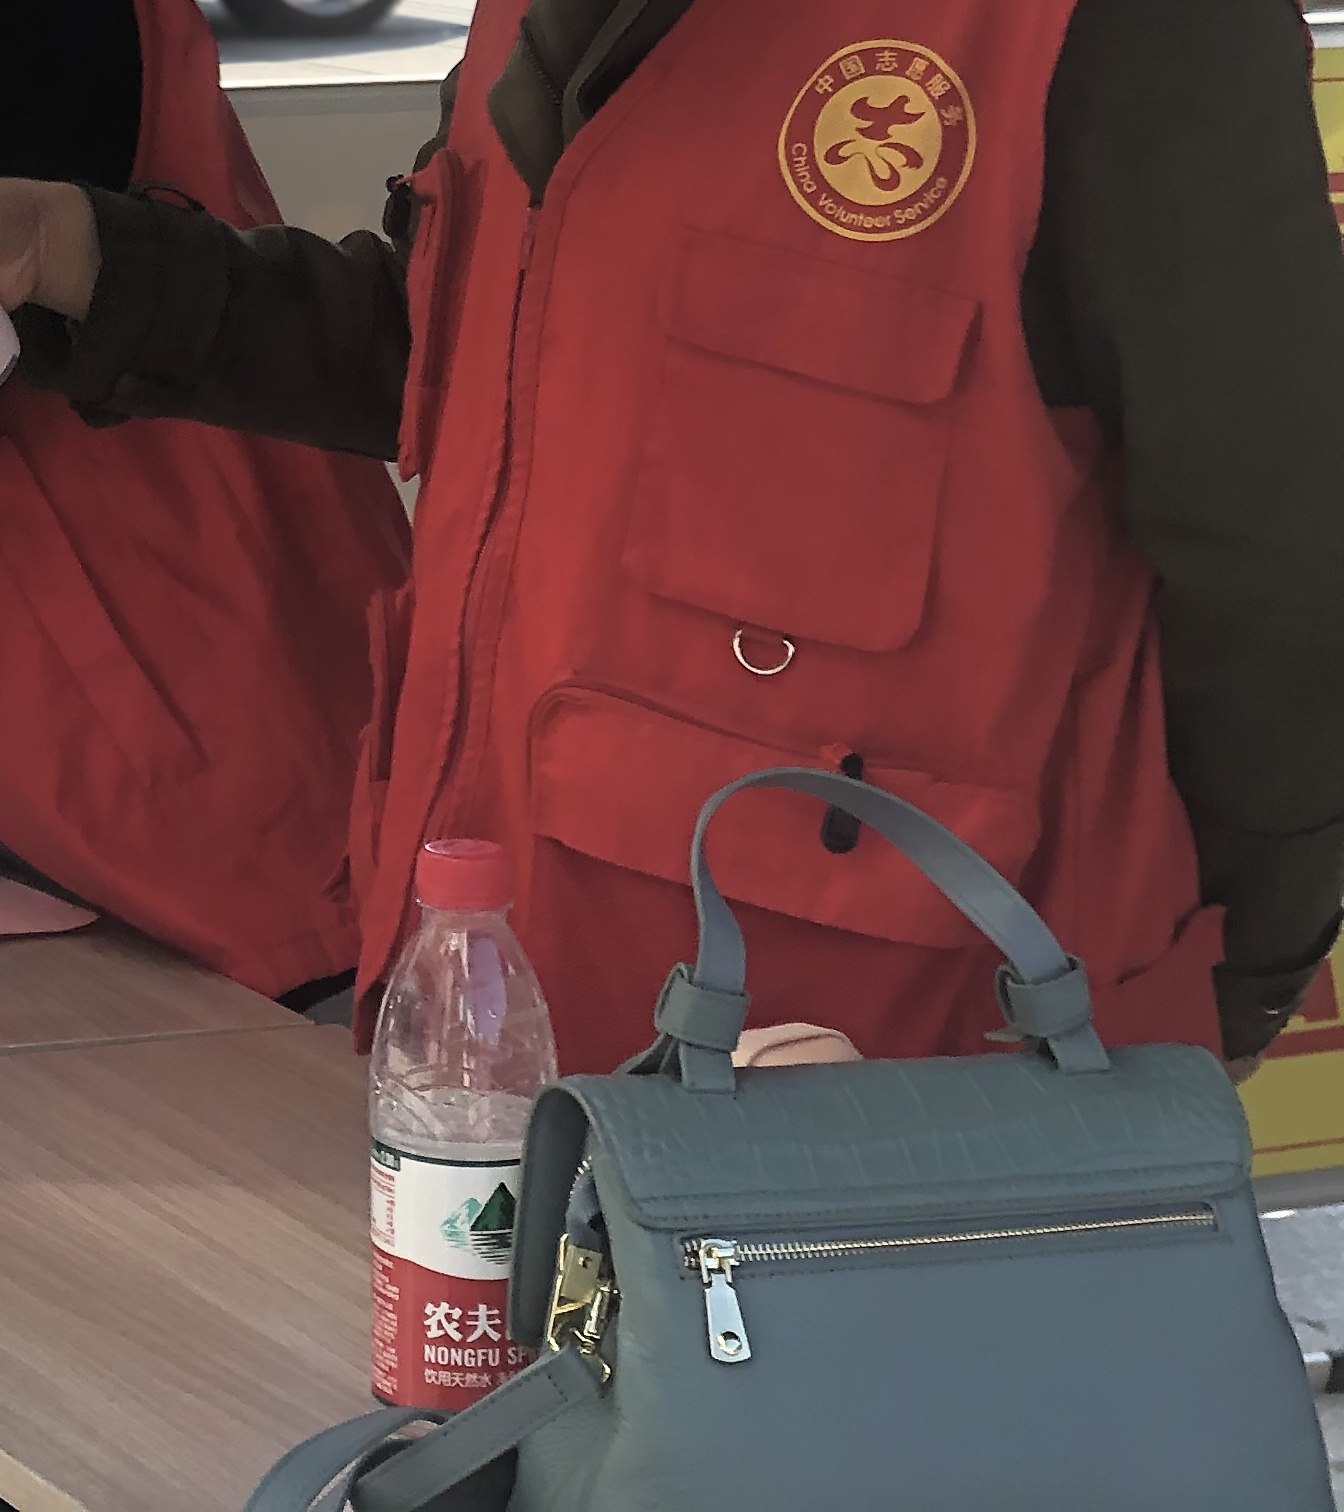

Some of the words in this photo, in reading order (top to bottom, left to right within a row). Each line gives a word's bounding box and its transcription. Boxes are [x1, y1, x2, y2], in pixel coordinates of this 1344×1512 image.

[815, 50, 963, 127] 中国志愿服务
[790, 142, 817, 194] China
[817, 192, 892, 229] Volunteer
[893, 176, 950, 226] Service
[423, 1301, 511, 1343] 农夫
[424, 1344, 500, 1368] NONGFU
[424, 1368, 492, 1388] 饮用天然水
